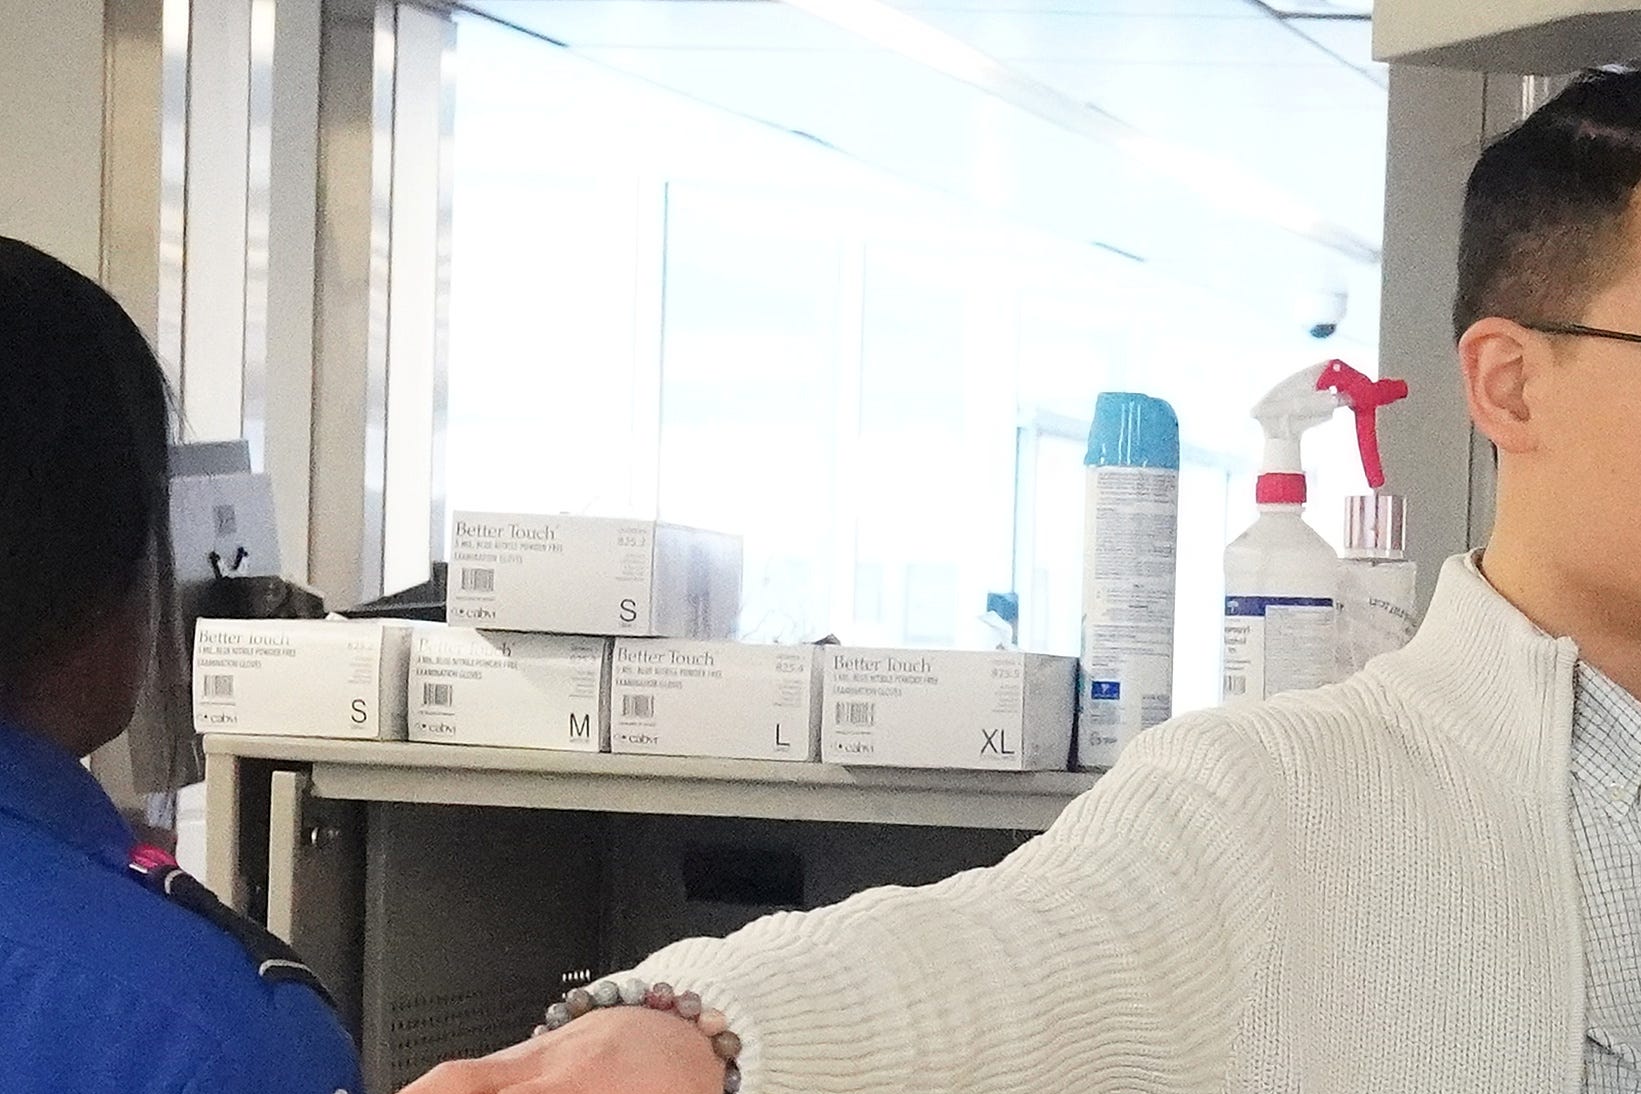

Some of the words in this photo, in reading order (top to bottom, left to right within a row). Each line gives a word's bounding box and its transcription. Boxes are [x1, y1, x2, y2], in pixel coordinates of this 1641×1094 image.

[456, 521, 504, 538] Better
[508, 524, 555, 540] Touch
[619, 598, 638, 623] S
[198, 630, 241, 644] Better
[247, 632, 290, 646] Touch
[618, 647, 665, 663] Better
[669, 649, 715, 666] Touch
[834, 655, 881, 671] Better
[884, 657, 931, 673] Touch
[350, 698, 368, 724] S
[569, 712, 590, 738] M
[776, 723, 790, 747] L
[980, 728, 1015, 756] XL
